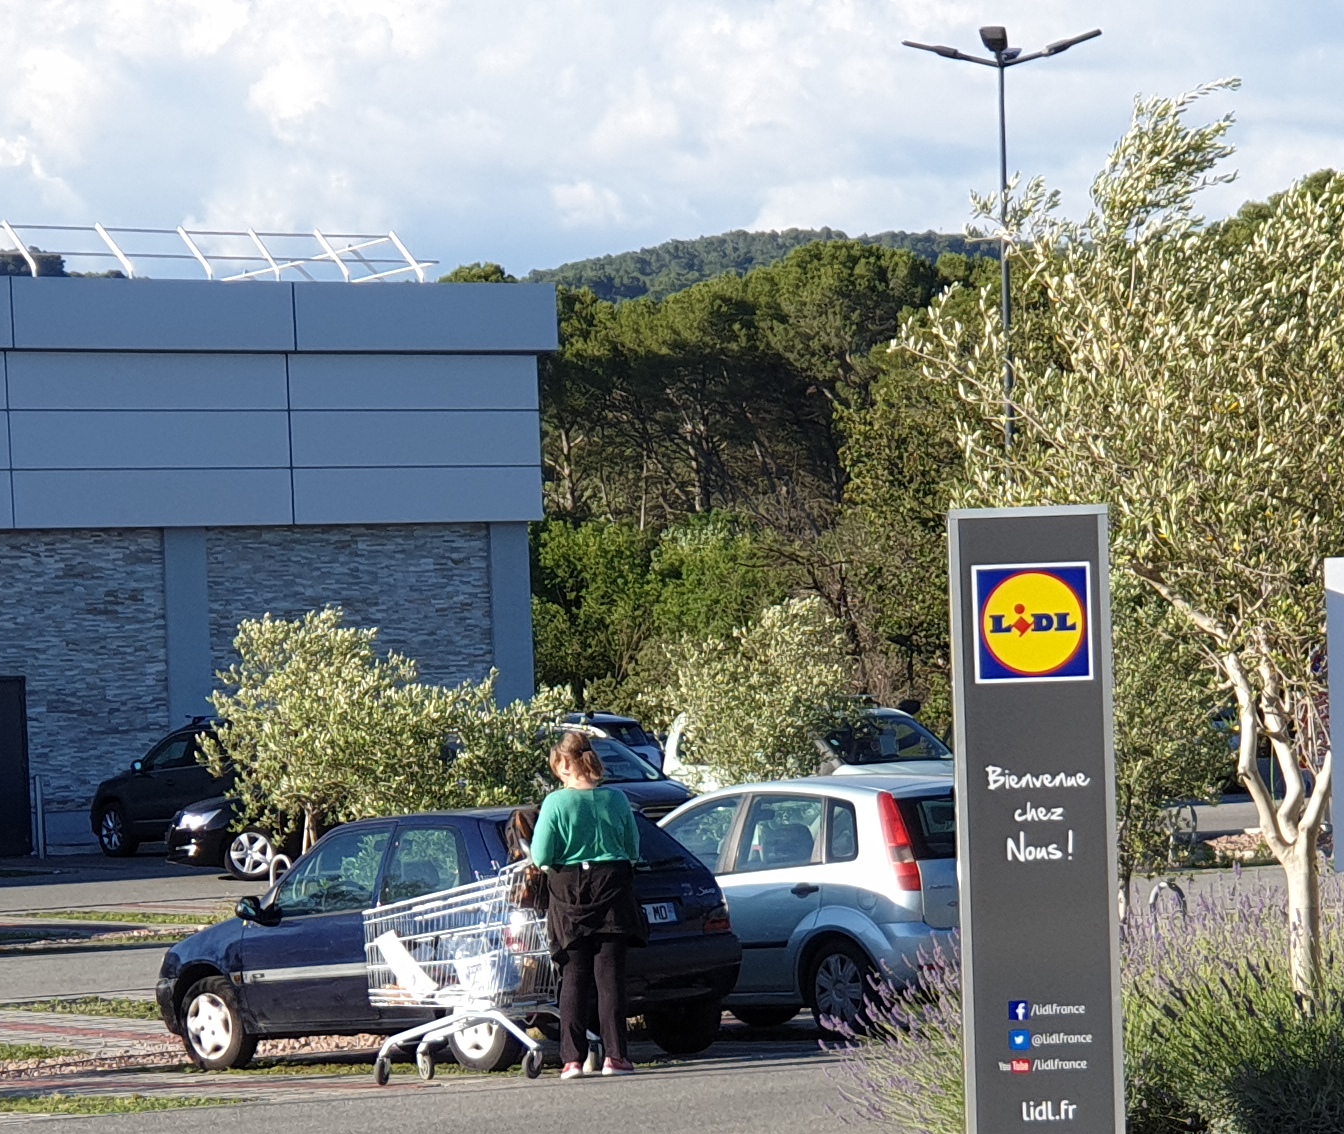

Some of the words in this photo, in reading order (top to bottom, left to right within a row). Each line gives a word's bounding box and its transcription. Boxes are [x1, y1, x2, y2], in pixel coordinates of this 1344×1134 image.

[985, 764, 1091, 790] Bienvenue
[1014, 802, 1064, 821] chez
[1031, 1033, 1093, 1046] @lidlfrance
[1022, 1100, 1077, 1121] lidl.fr
